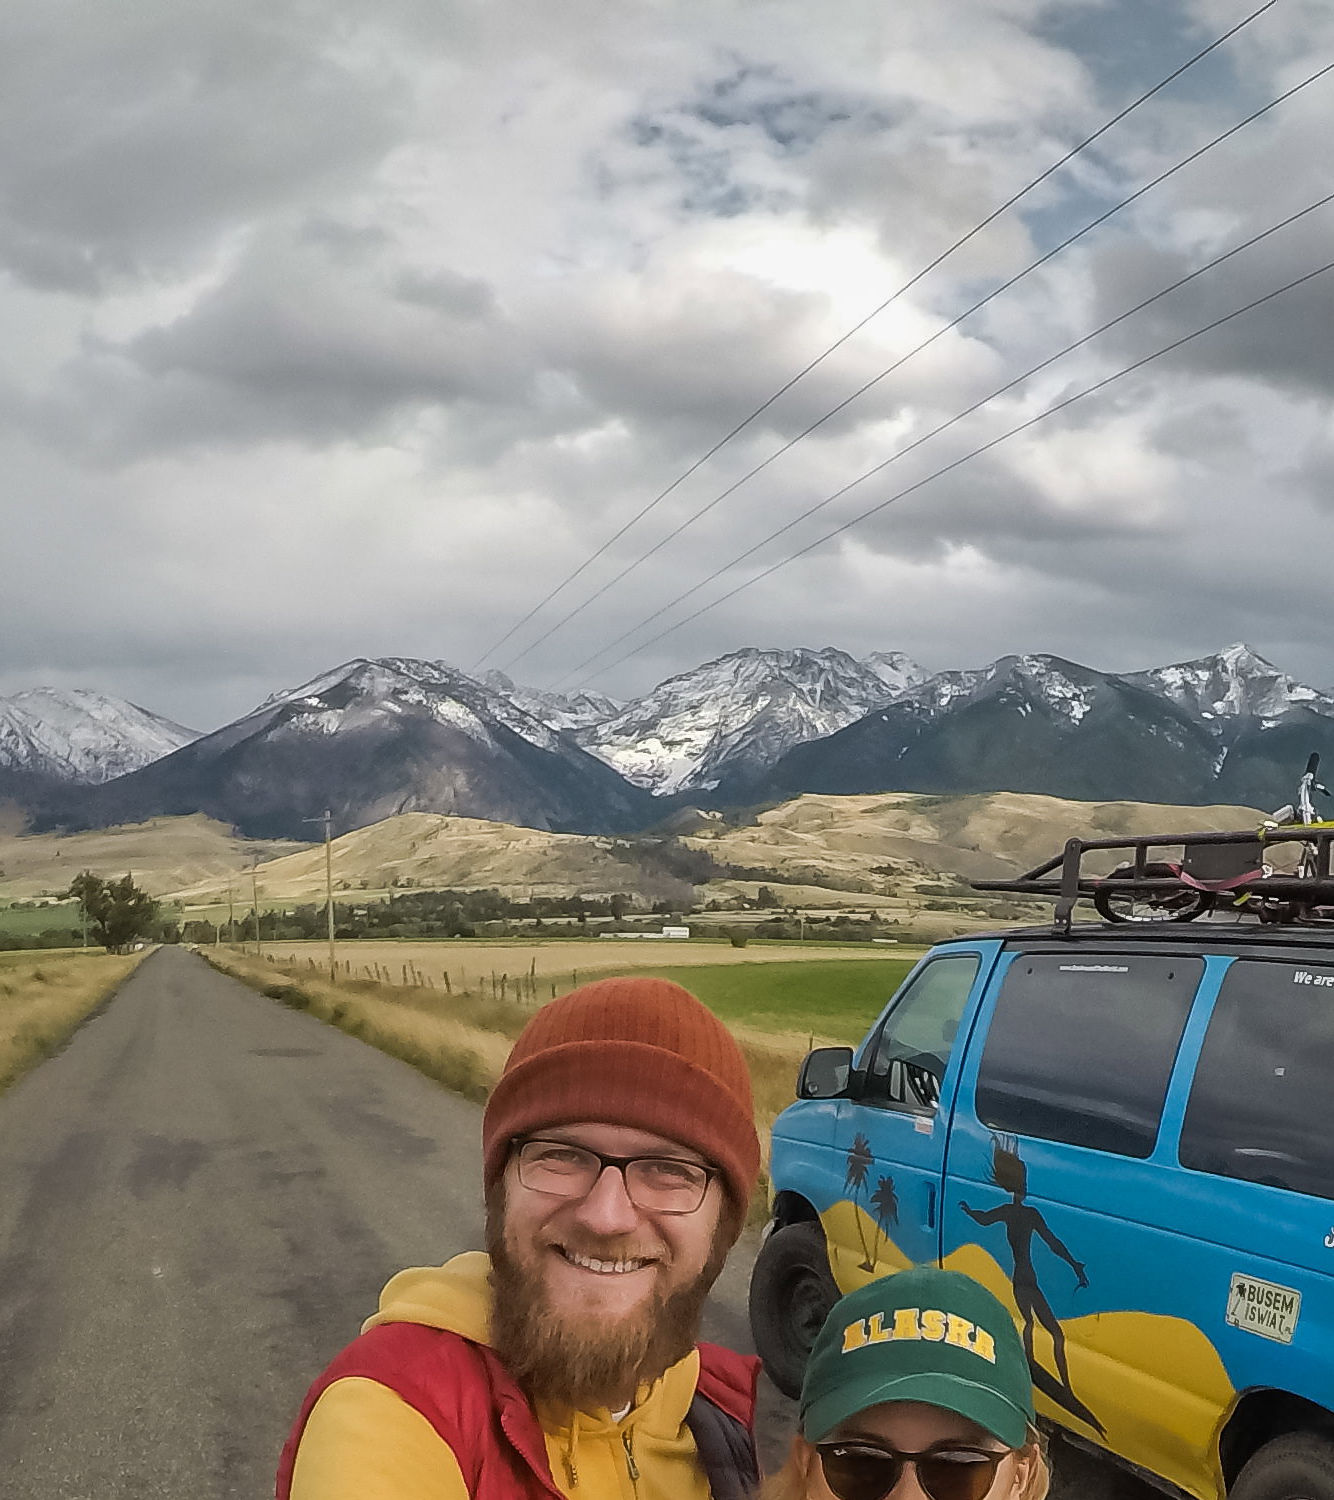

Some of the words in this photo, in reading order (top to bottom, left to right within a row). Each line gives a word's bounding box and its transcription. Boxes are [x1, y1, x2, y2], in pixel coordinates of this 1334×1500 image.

[1293, 971, 1313, 985] We
[1313, 974, 1334, 987] are
[1247, 1284, 1295, 1315] BUSEM
[841, 1307, 997, 1365] ALASKA
